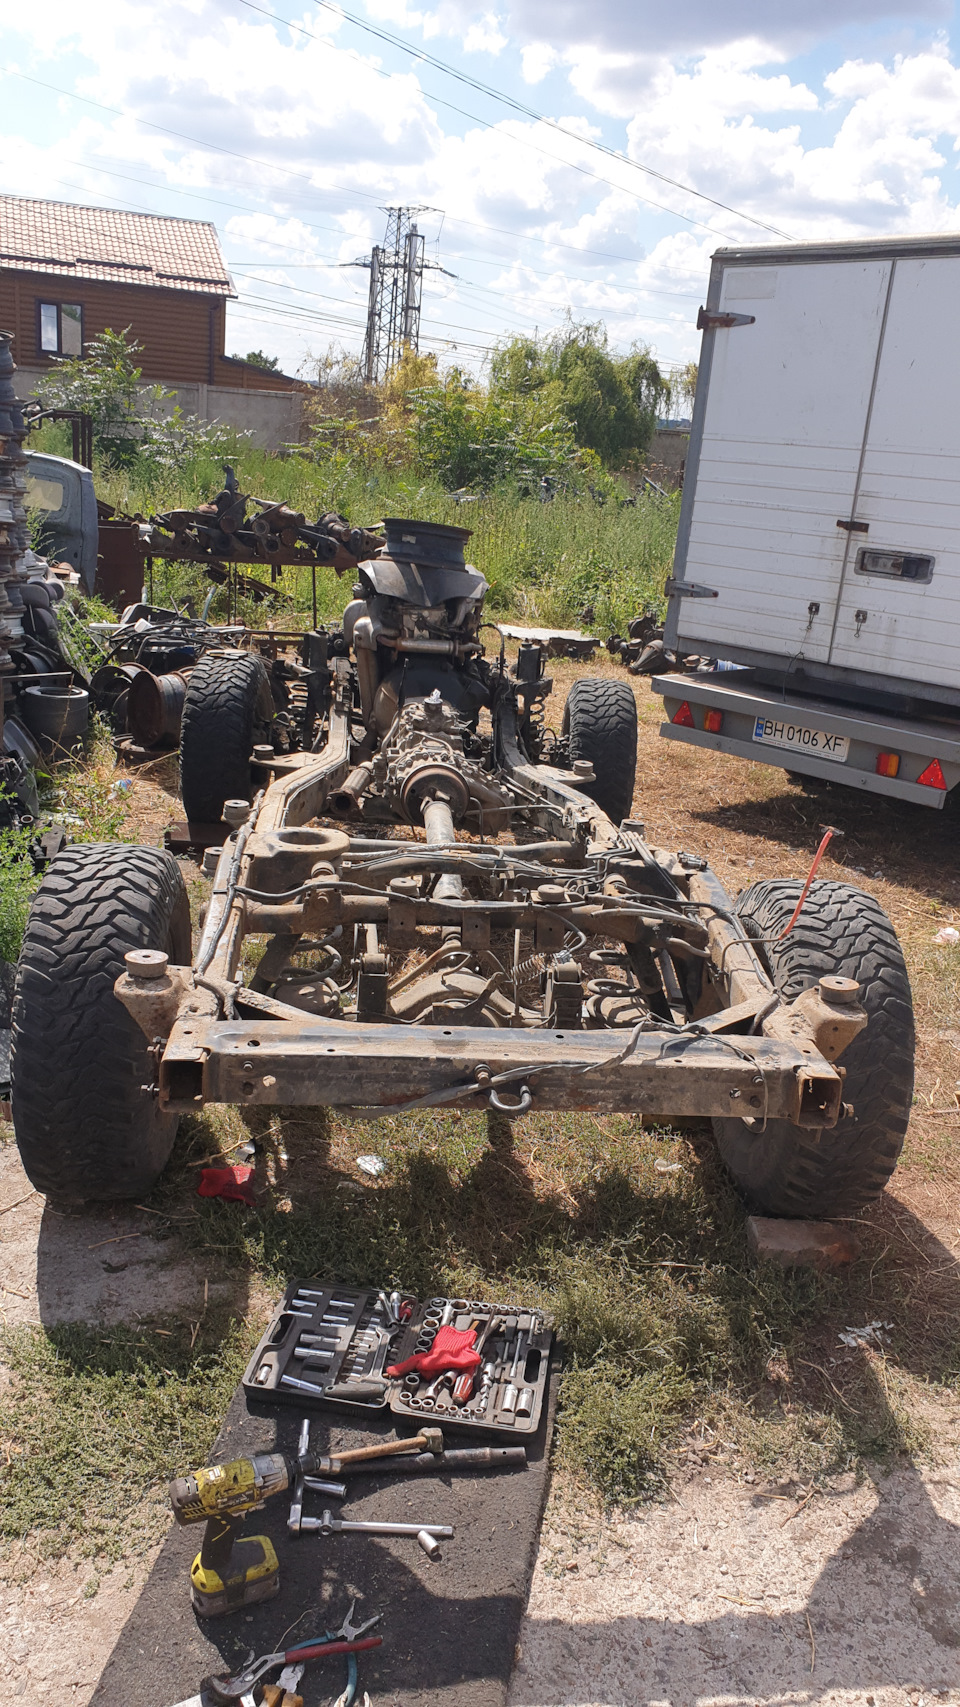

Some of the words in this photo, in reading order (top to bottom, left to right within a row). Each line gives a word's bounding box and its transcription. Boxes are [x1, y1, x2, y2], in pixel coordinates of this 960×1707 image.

[763, 720, 785, 739] BH
[787, 726, 819, 747] 0106
[822, 733, 845, 752] XF
